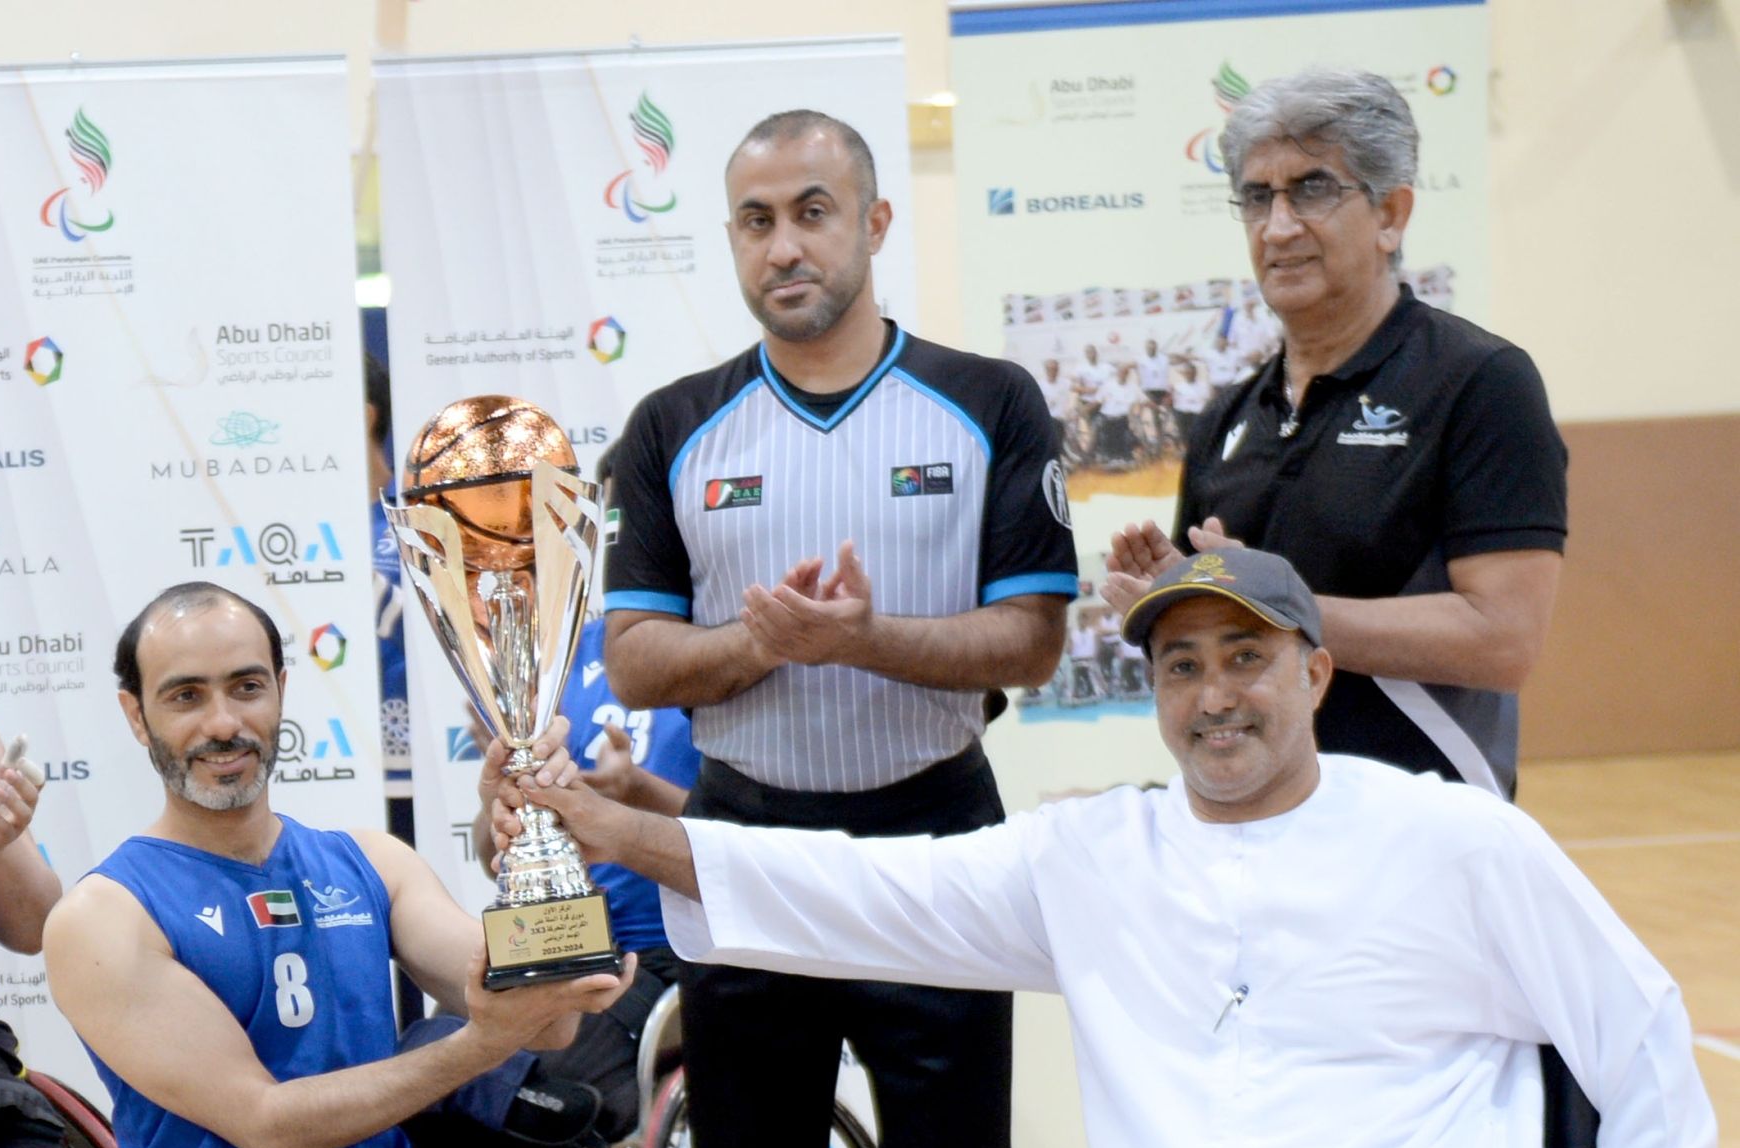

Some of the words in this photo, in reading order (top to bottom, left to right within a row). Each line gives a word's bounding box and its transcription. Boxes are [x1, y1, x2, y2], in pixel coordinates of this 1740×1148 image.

[1026, 192, 1145, 214] BOREALIS
[216, 325, 259, 344] Abu
[268, 321, 331, 343] Dhabi
[217, 348, 269, 367] Sports
[274, 345, 332, 363] Council
[426, 352, 469, 367] General
[473, 350, 522, 365] Authority
[526, 349, 536, 361] of
[539, 348, 575, 363] Sports
[151, 454, 339, 480] MUBADALA
[179, 521, 343, 567] TAQA
[18, 632, 83, 654] Dhabi
[25, 657, 84, 676] Council
[584, 704, 655, 765] 23
[542, 943, 584, 955] 2023-2024
[11, 993, 47, 1008] Sports
[273, 952, 315, 1028] 8
